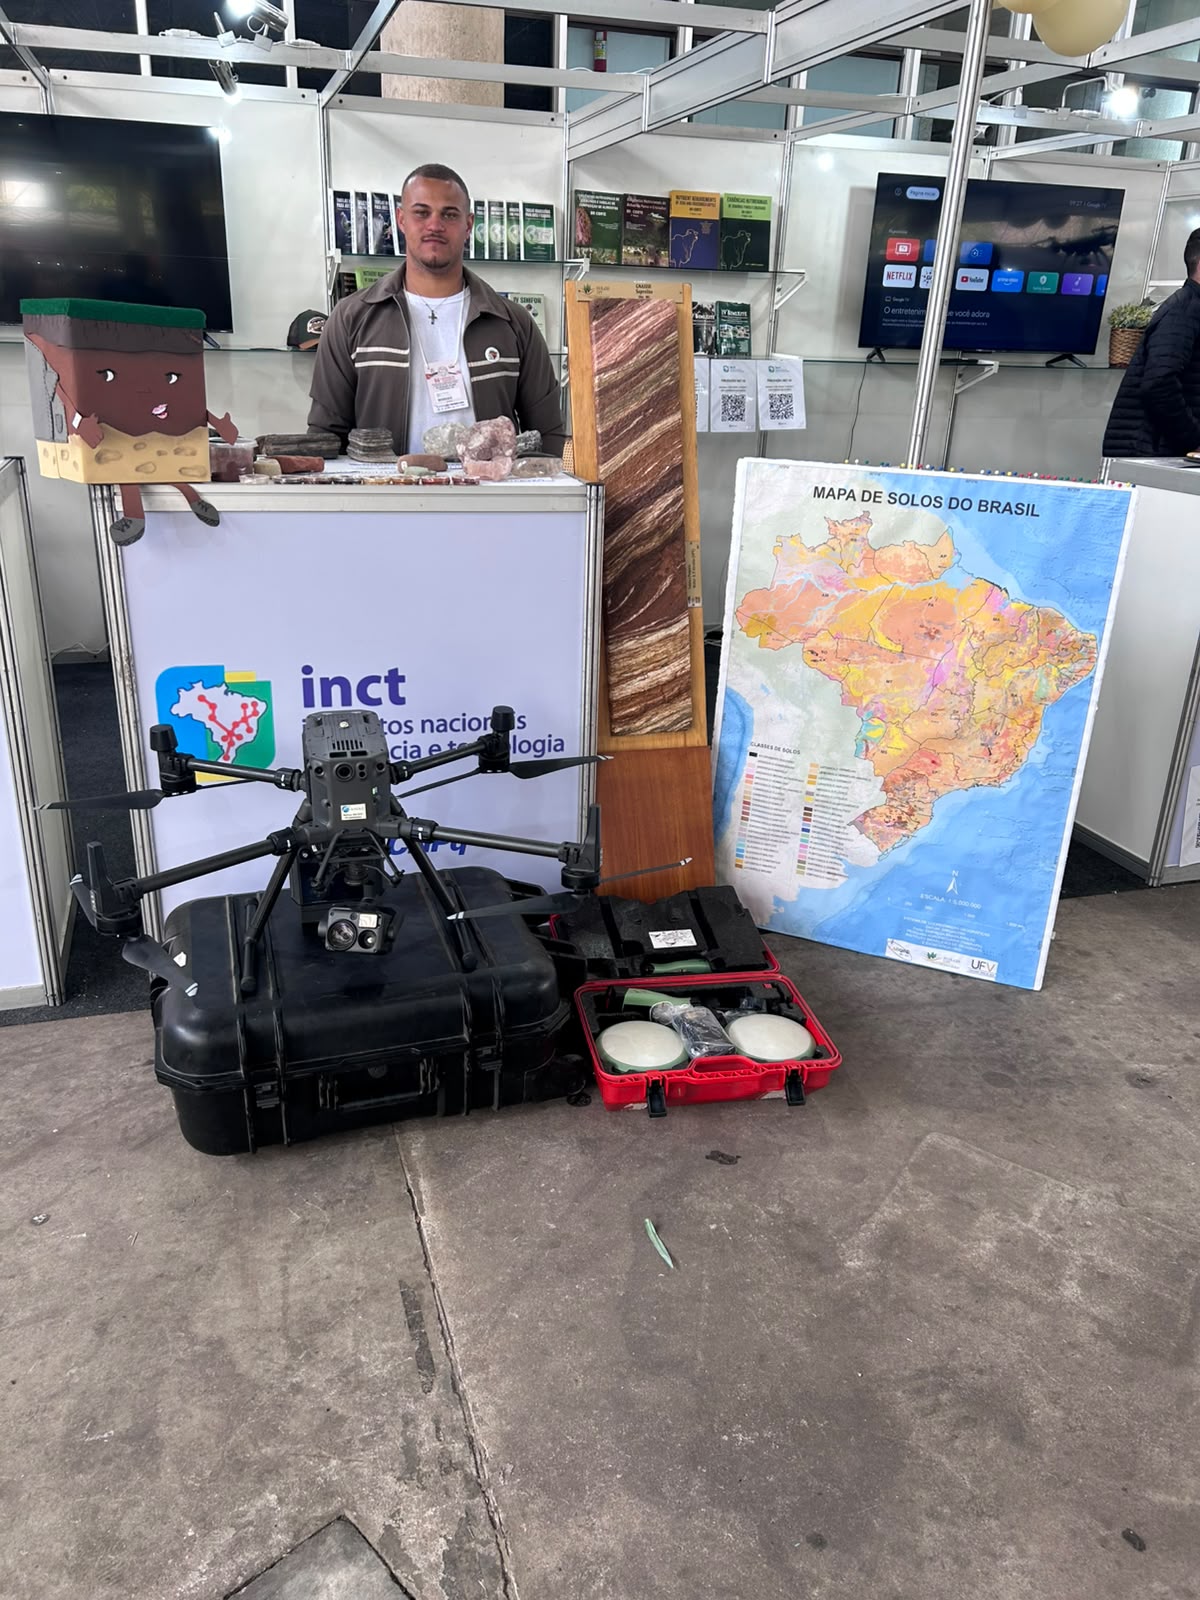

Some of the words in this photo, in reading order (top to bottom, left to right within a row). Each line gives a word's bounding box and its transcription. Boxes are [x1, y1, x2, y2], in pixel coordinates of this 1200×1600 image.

[886, 271, 913, 281] NETFLIX
[971, 311, 990, 319] adora
[813, 486, 857, 502] MAPA
[860, 489, 883, 504] DE
[887, 491, 943, 509] SOLOS
[948, 496, 973, 511] DO
[977, 499, 1040, 518] BRASIL
[301, 664, 406, 708] inct
[750, 741, 774, 751] CLASSES
[782, 747, 801, 756] SOLOS
[920, 893, 945, 903] ESCALA
[970, 959, 996, 973] UFV
